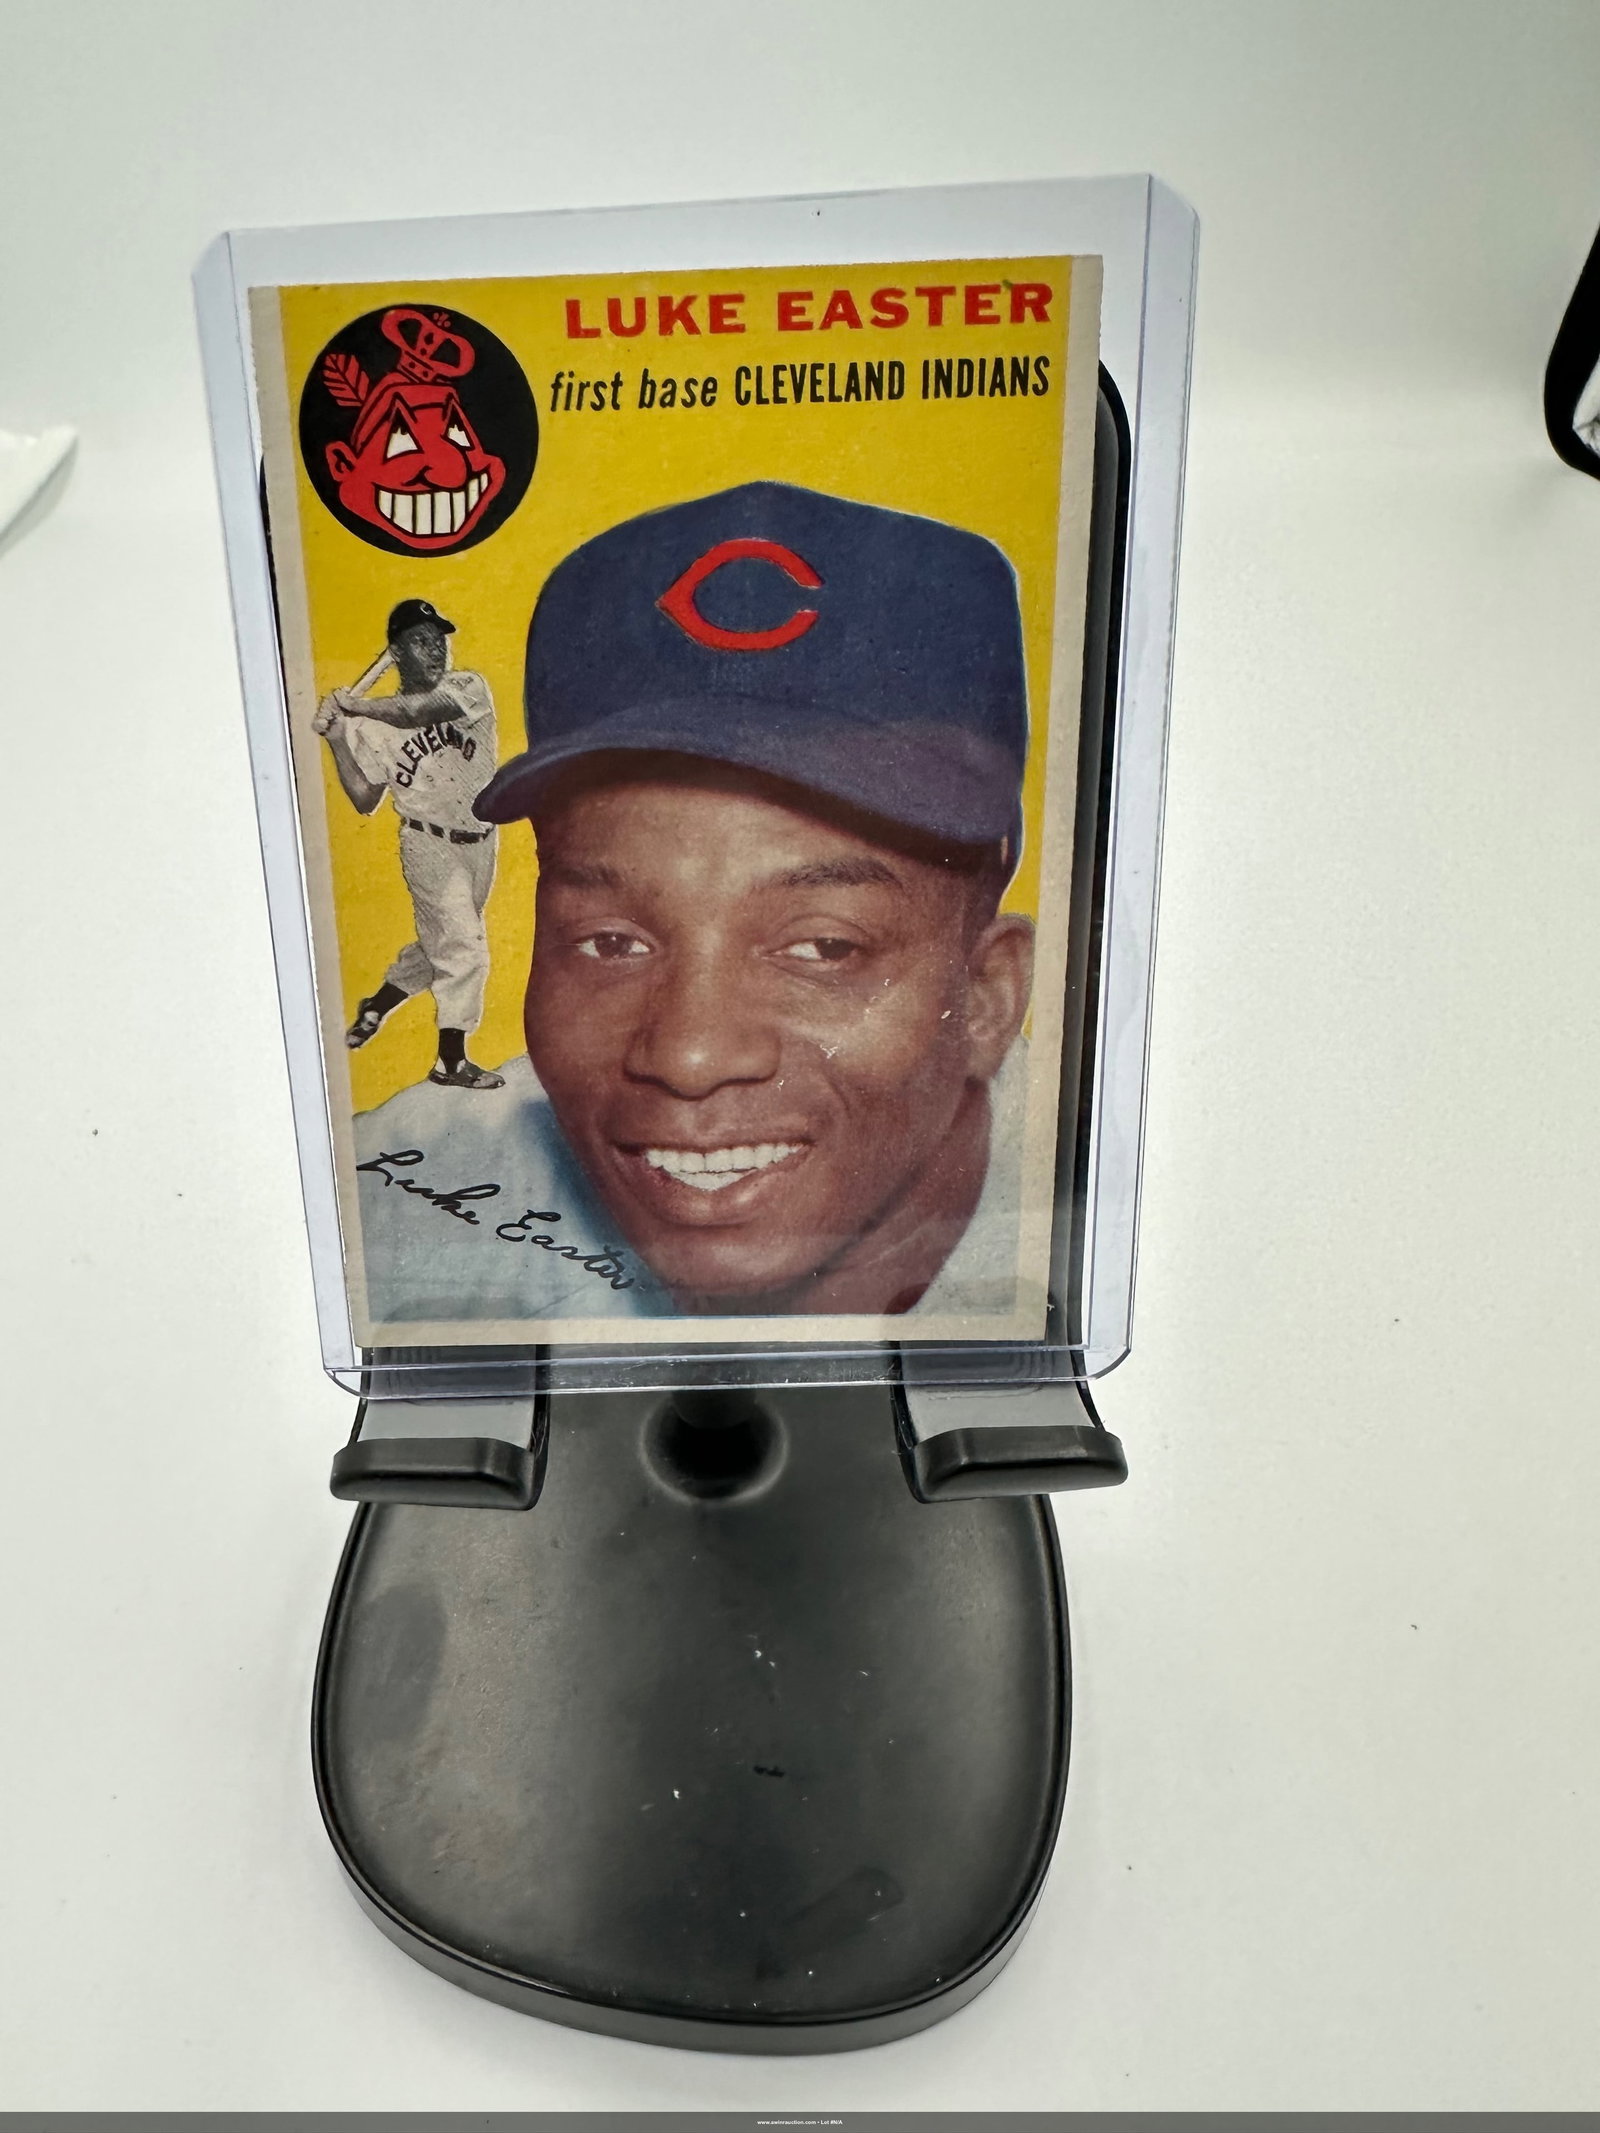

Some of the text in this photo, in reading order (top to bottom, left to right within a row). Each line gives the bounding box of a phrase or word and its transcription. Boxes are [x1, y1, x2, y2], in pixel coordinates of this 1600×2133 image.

[565, 282, 1053, 339] LUKE EASTER
[549, 355, 1051, 413] first base CLEVELAND INDIANS
[655, 537, 825, 652] C
